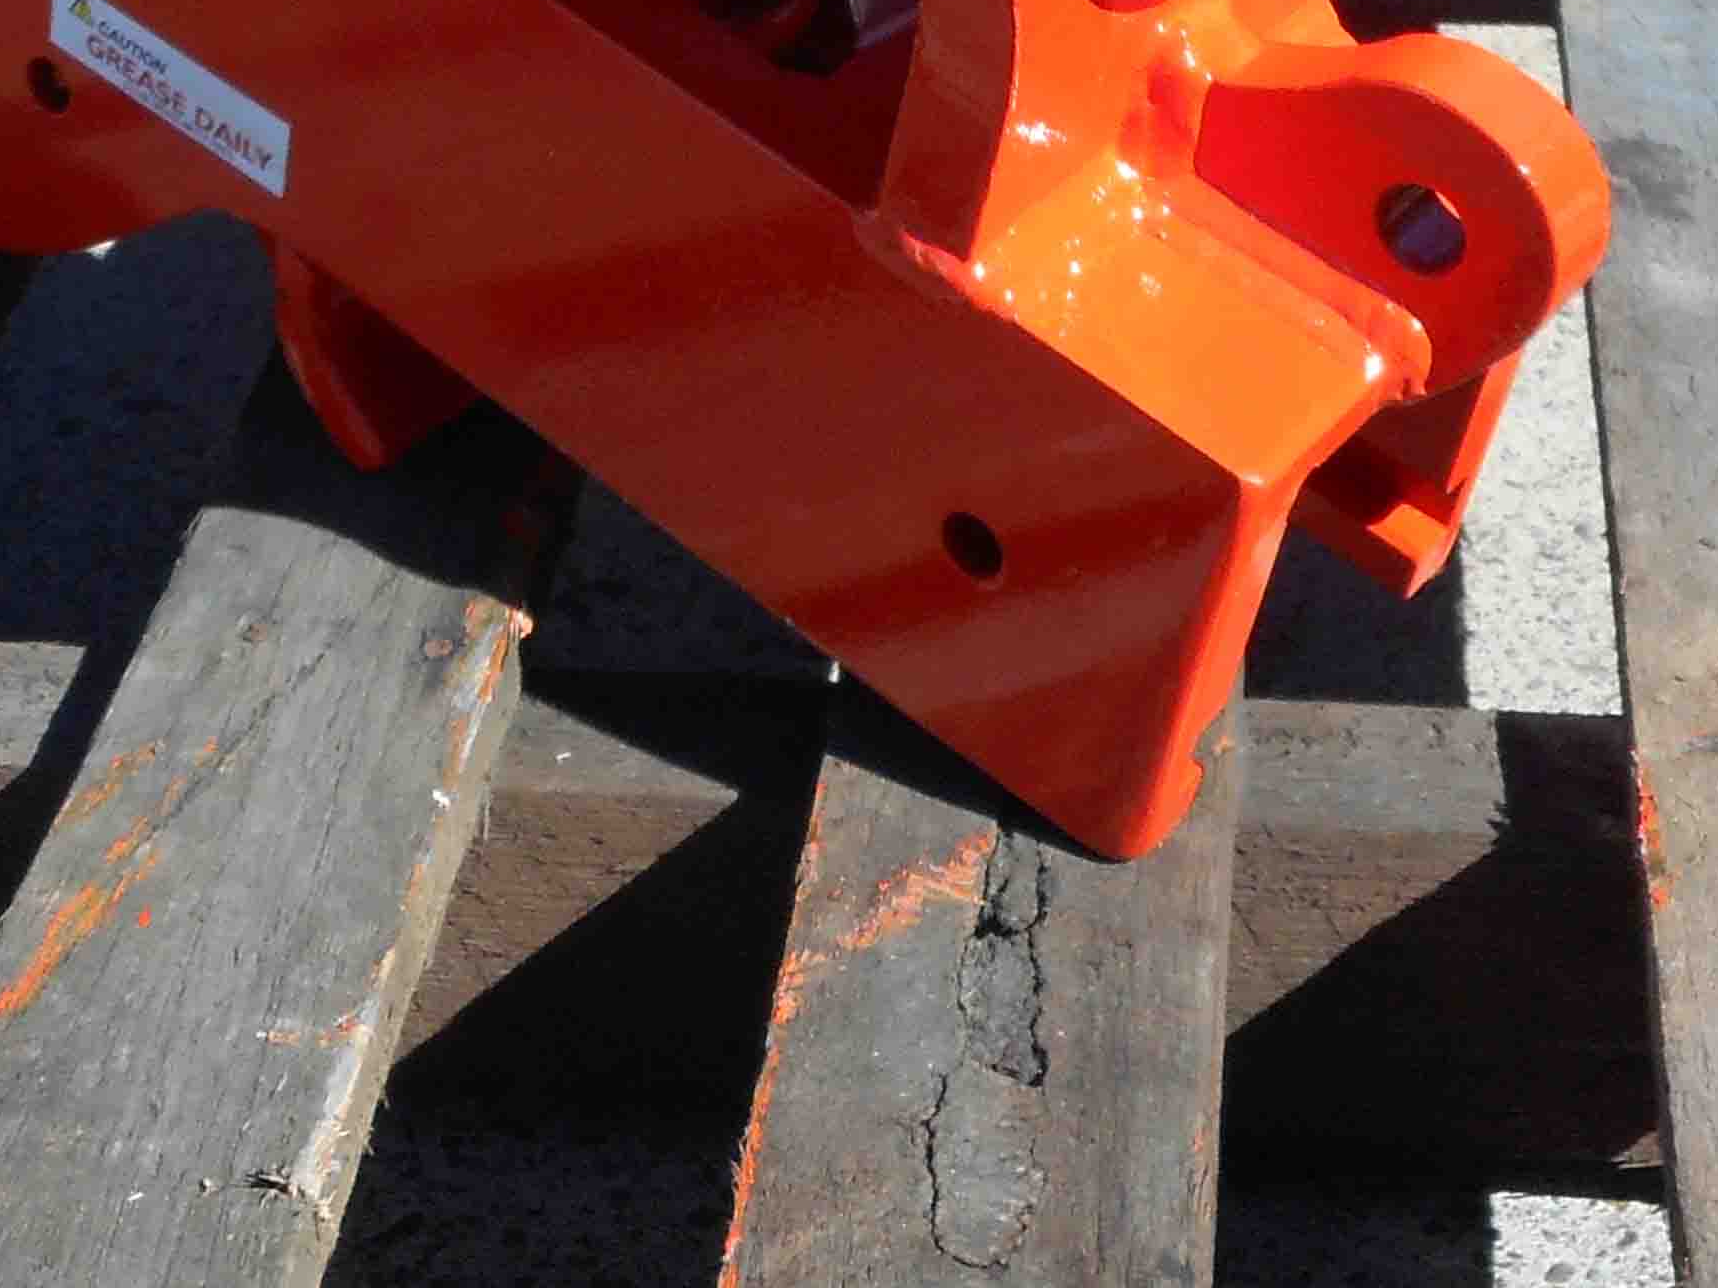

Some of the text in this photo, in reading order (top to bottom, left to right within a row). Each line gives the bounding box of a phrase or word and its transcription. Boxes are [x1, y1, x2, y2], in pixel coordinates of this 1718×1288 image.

[96, 20, 169, 75] CAUTION
[85, 34, 189, 113] GREASE
[193, 106, 274, 171] DAILY
